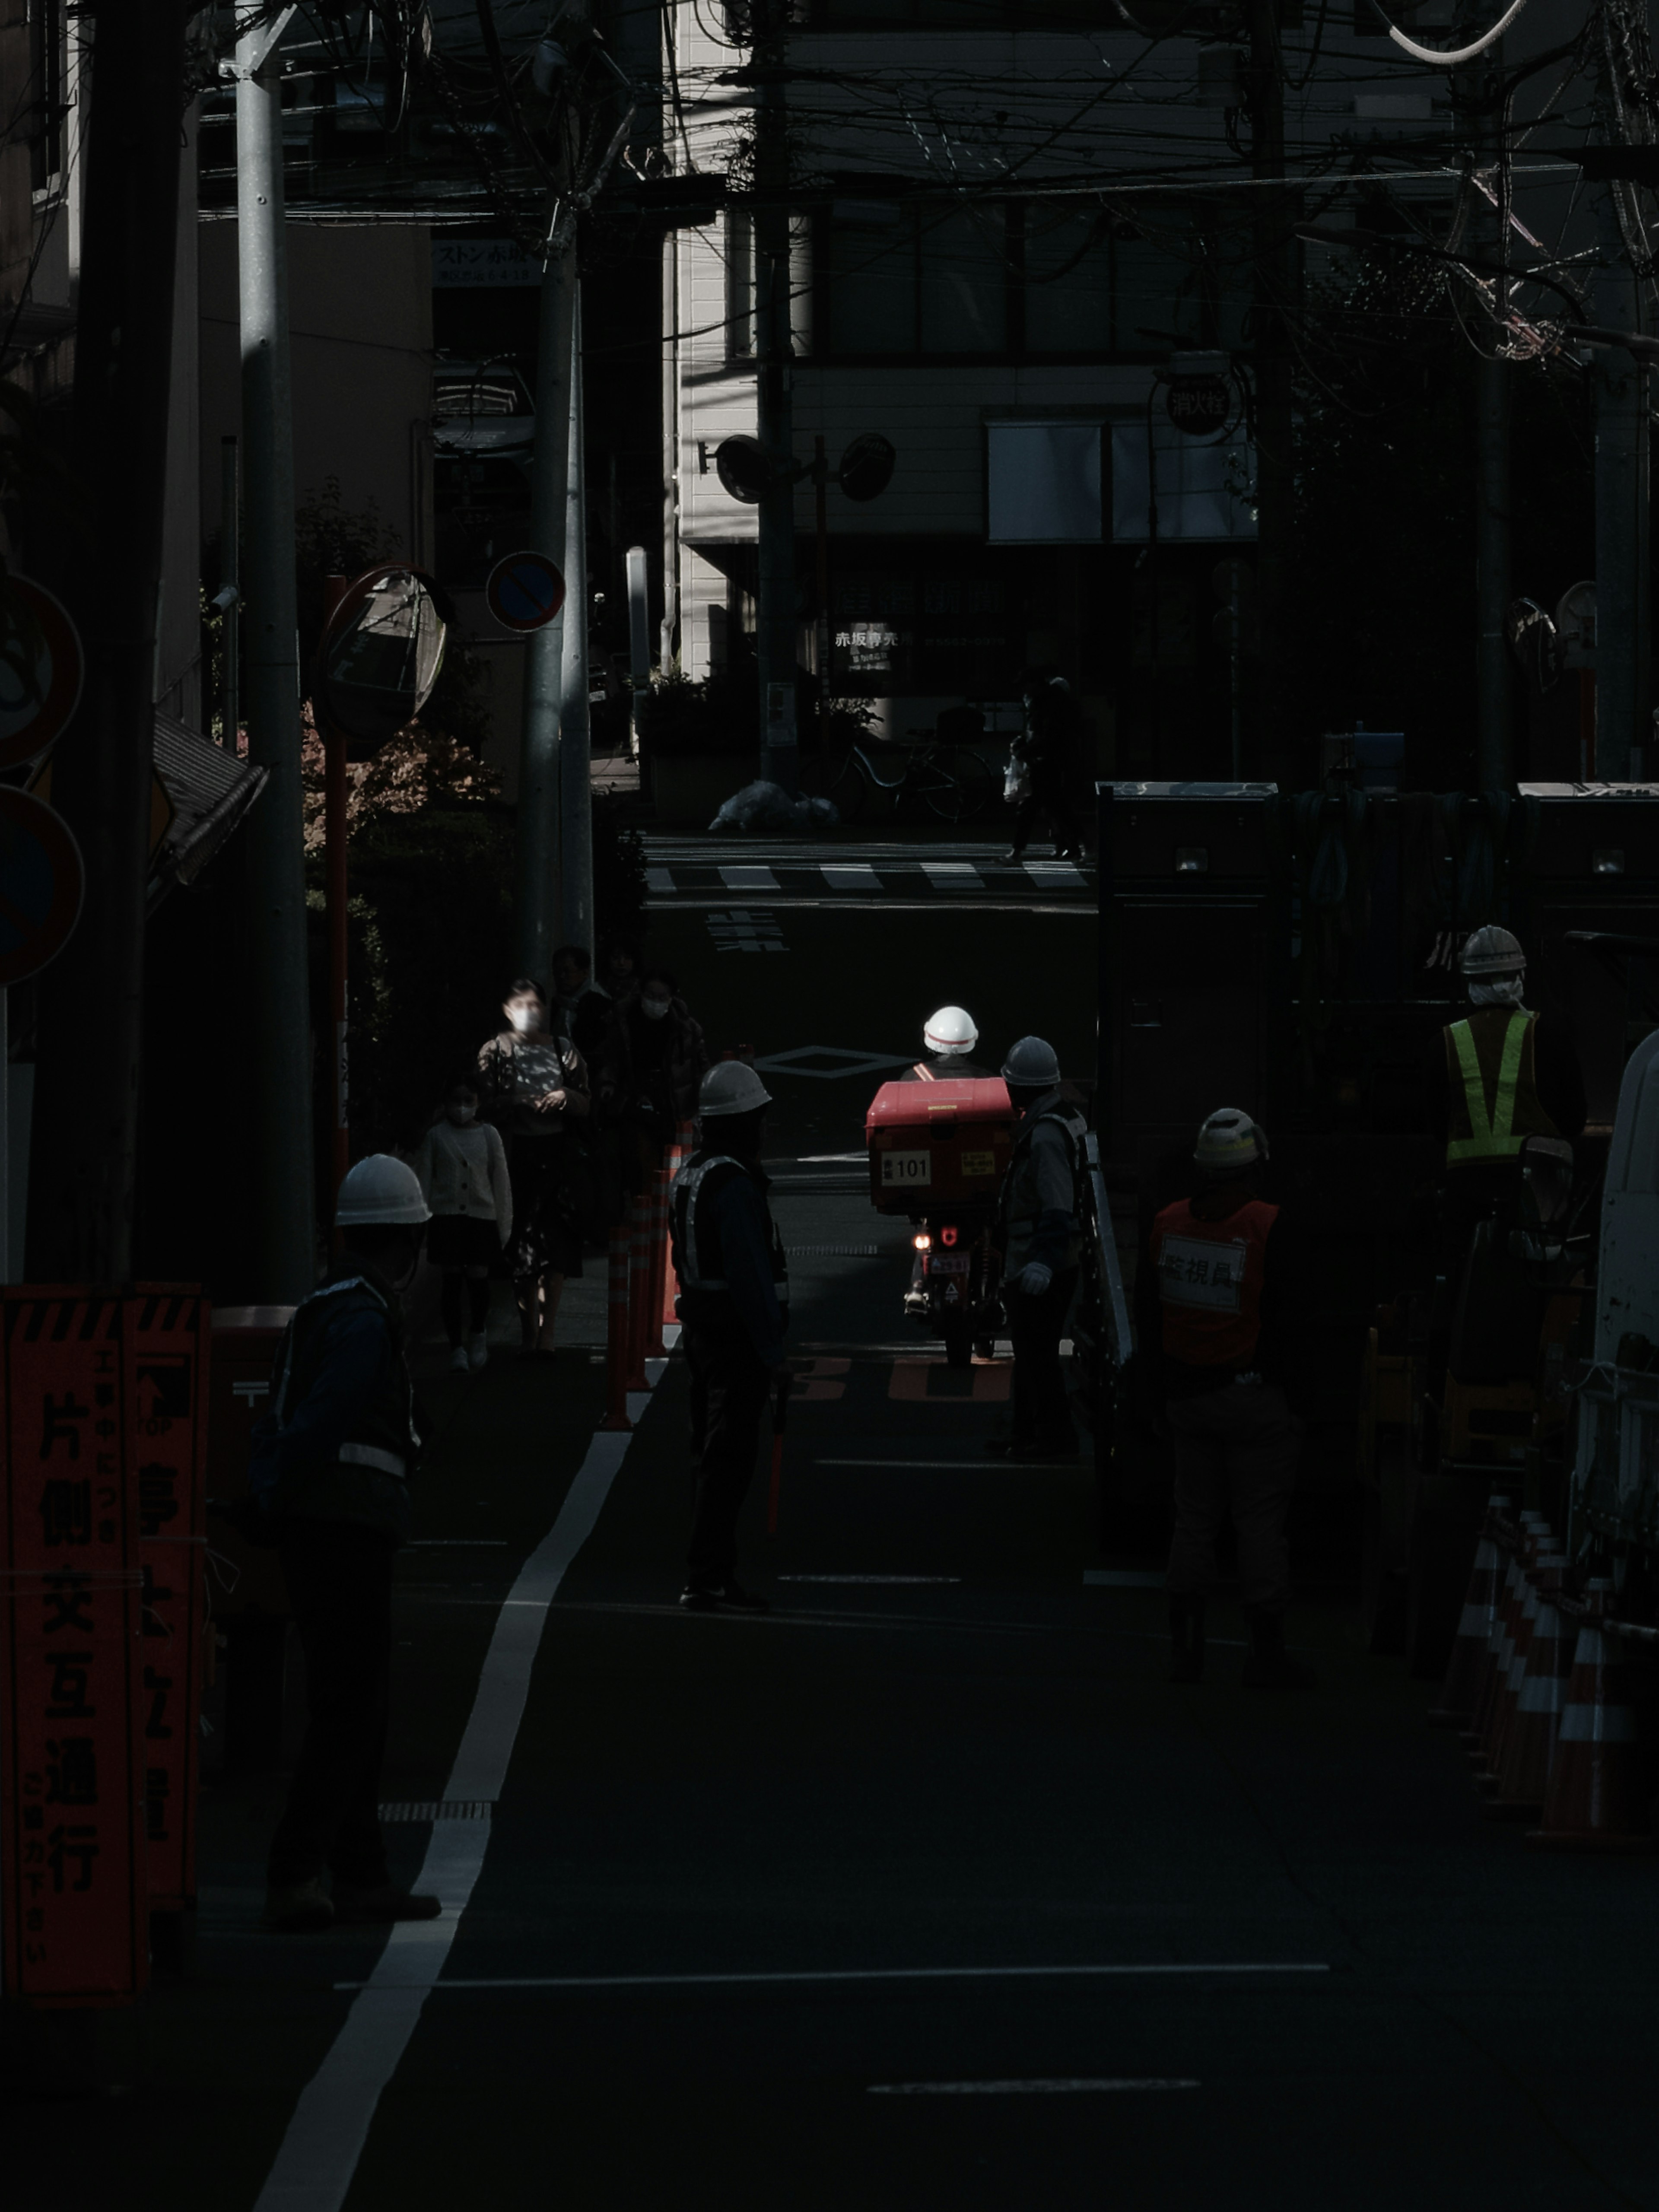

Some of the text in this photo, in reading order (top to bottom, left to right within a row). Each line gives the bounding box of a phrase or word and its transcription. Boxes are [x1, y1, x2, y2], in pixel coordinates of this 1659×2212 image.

[1172, 390, 1226, 416] 消火栓
[897, 1159, 926, 1178] 101
[1165, 1255, 1232, 1288] 監視員
[40, 1392, 99, 1893] 片側交互通行
